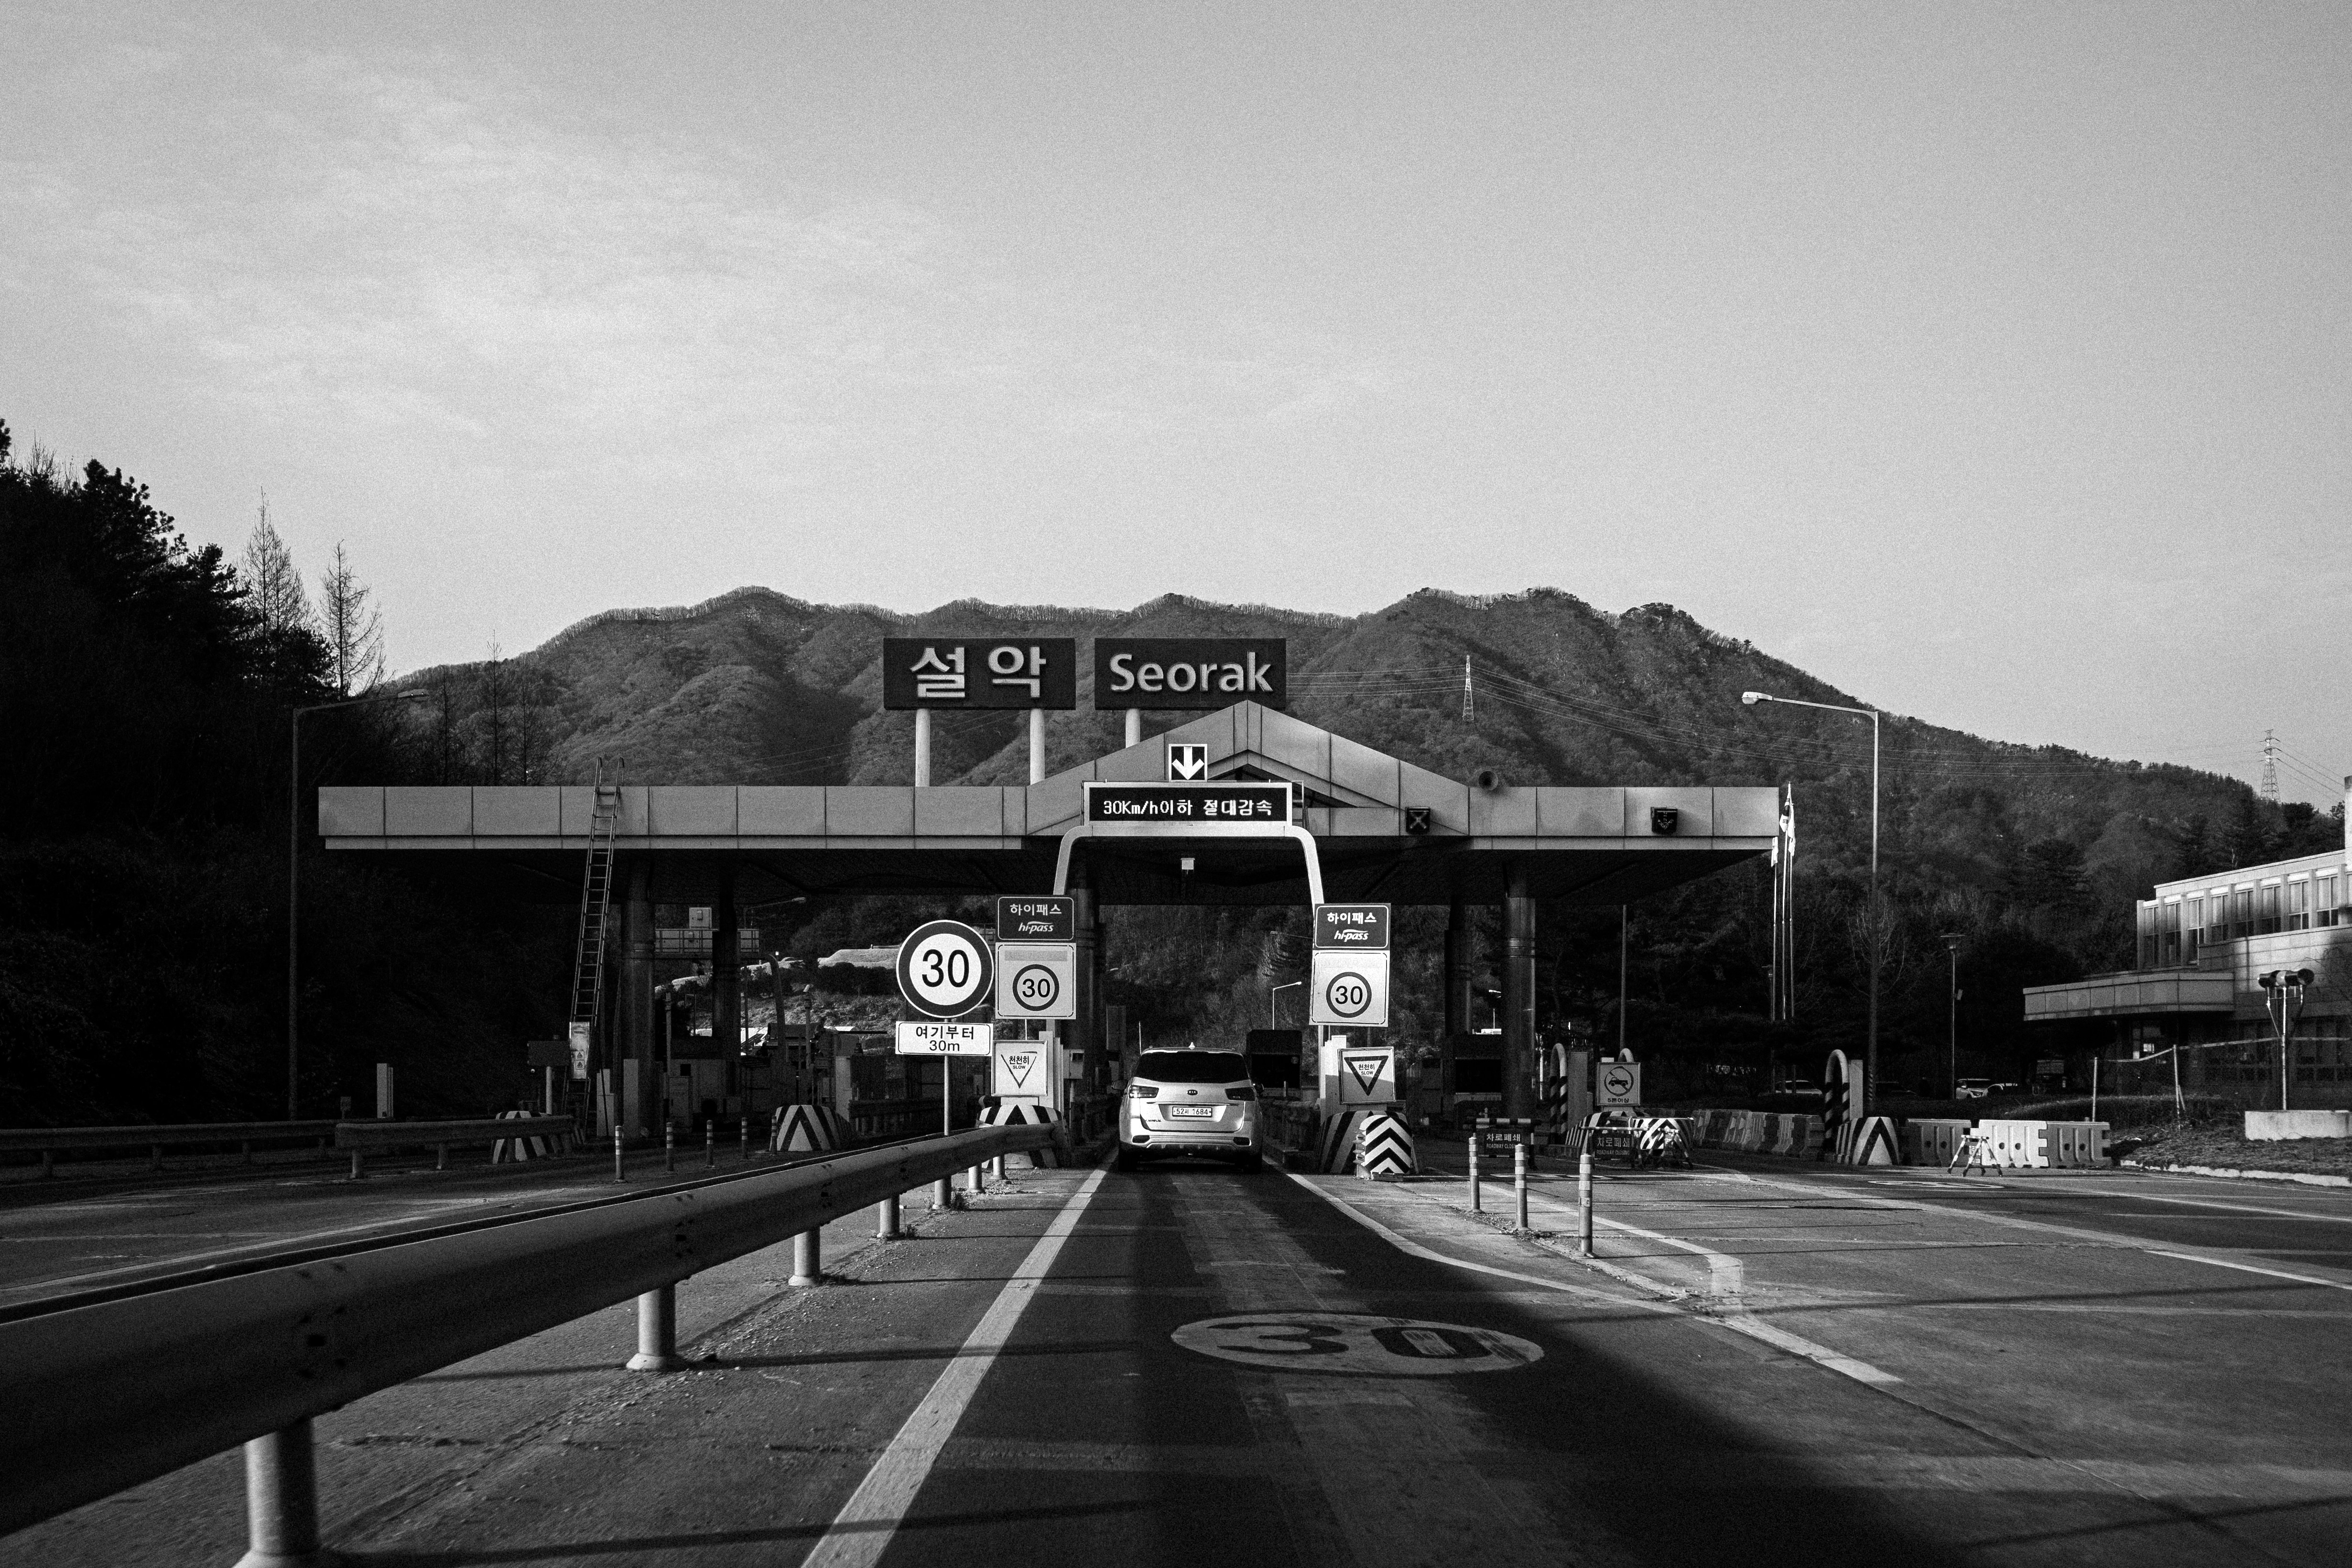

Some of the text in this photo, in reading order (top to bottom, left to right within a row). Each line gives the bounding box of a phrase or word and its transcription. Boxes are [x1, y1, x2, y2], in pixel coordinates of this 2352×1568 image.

[910, 646, 1046, 698] 설악
[1110, 651, 1273, 692] Seorak
[1104, 799, 1272, 816] 30Km/h이하 절대감속
[1009, 903, 1062, 916] 하이패스
[1327, 912, 1377, 925] 하이패스
[921, 949, 969, 988] 30
[1022, 978, 1051, 998] 30
[1335, 985, 1363, 1005] 30
[915, 1025, 975, 1040] 여기부터
[929, 1040, 960, 1052] 30m
[1009, 1055, 1030, 1065] 천천히
[1486, 1133, 1520, 1142] 차로폐쇄
[1597, 1137, 1630, 1148] 차로폐쇄
[1206, 1322, 1494, 1358] 30
